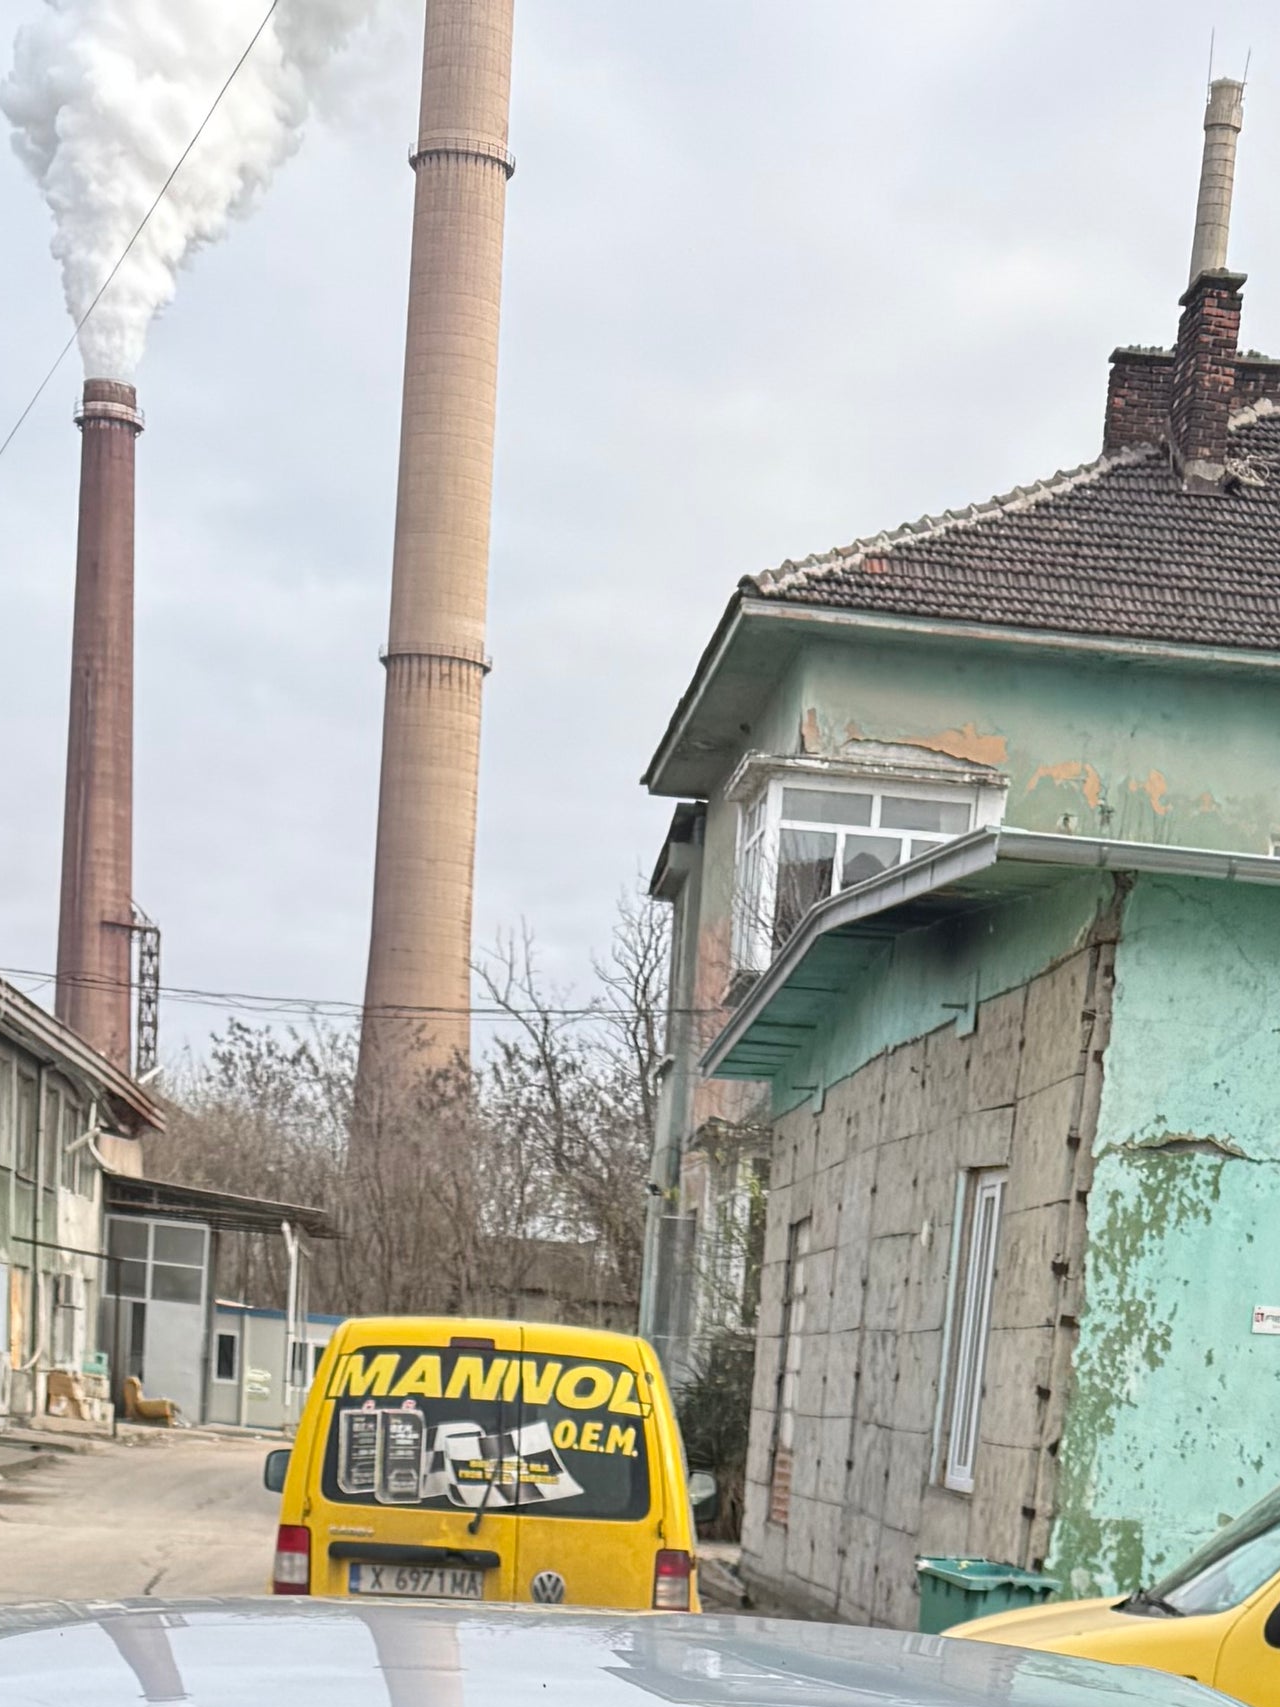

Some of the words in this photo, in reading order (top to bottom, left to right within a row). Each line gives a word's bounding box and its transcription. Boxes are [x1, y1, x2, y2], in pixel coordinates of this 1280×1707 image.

[329, 1354, 651, 1416] MANNOL
[554, 1420, 638, 1457] O.E.M.
[370, 1567, 384, 1590] X
[395, 1567, 445, 1593] 6971
